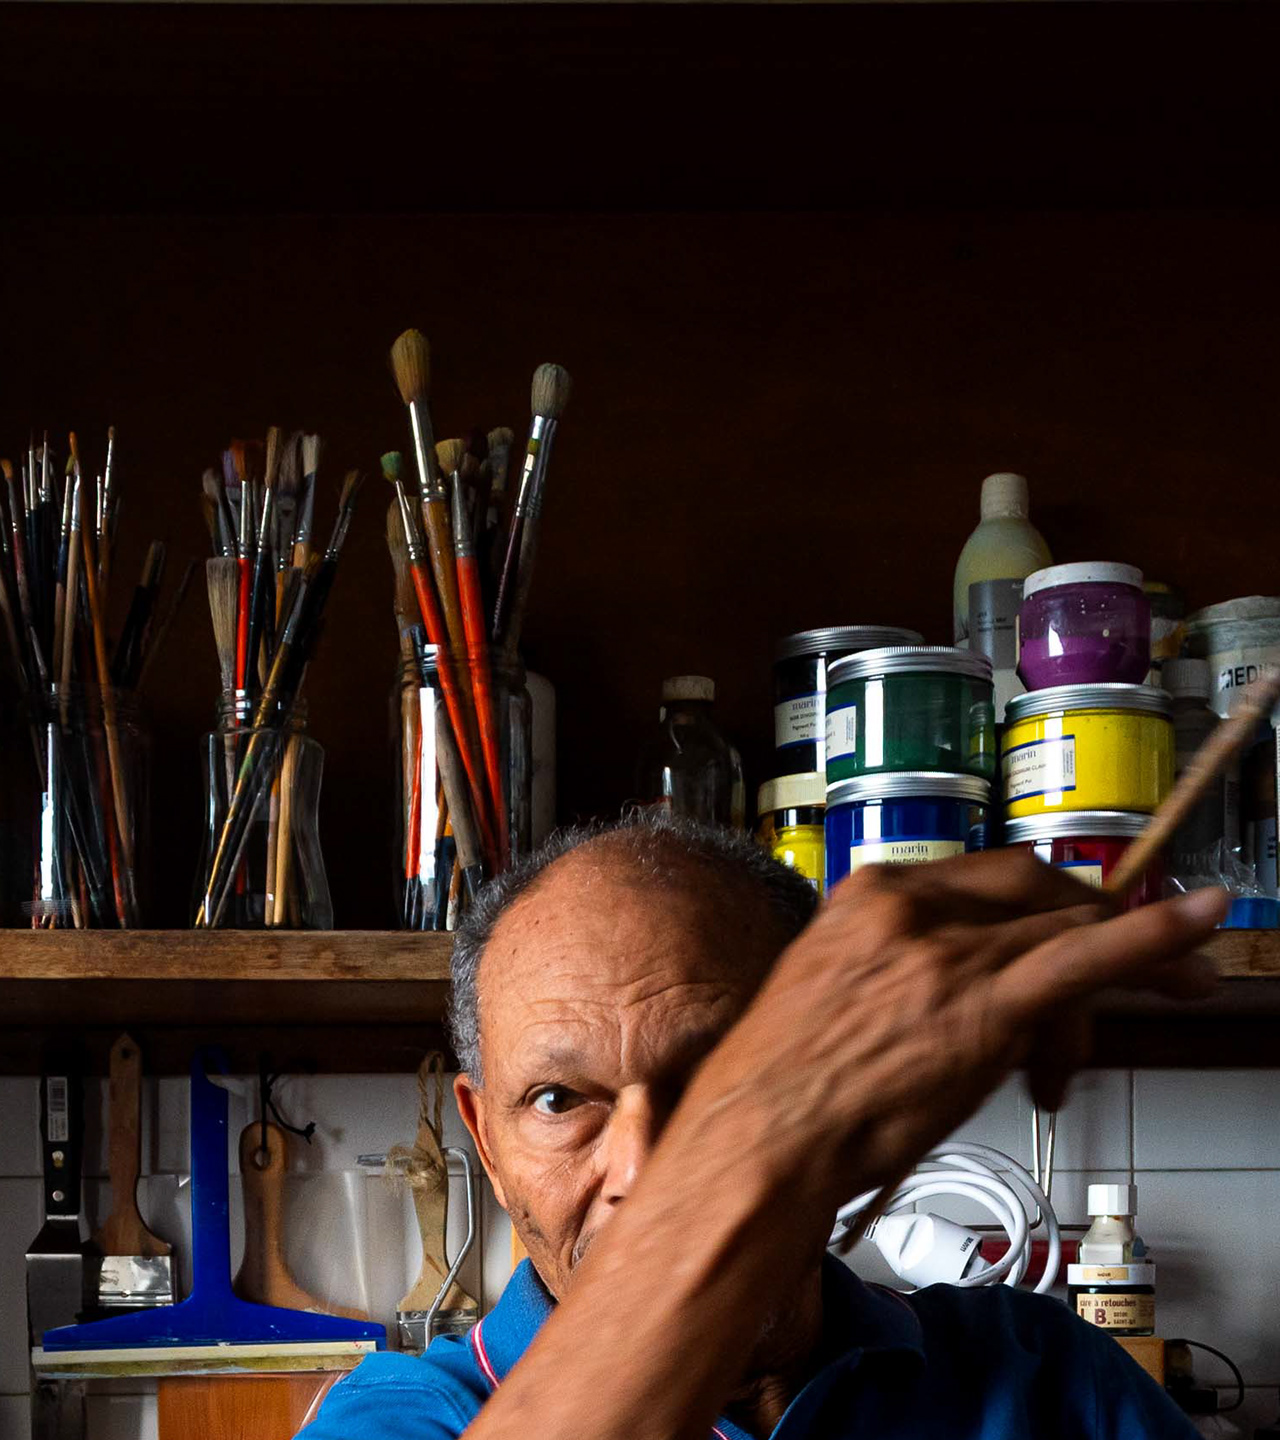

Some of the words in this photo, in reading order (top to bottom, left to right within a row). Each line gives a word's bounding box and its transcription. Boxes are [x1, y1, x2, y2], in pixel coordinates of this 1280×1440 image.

[1011, 749, 1037, 764] marin
[891, 843, 928, 854] marin
[1100, 1298, 1136, 1307] retouches
